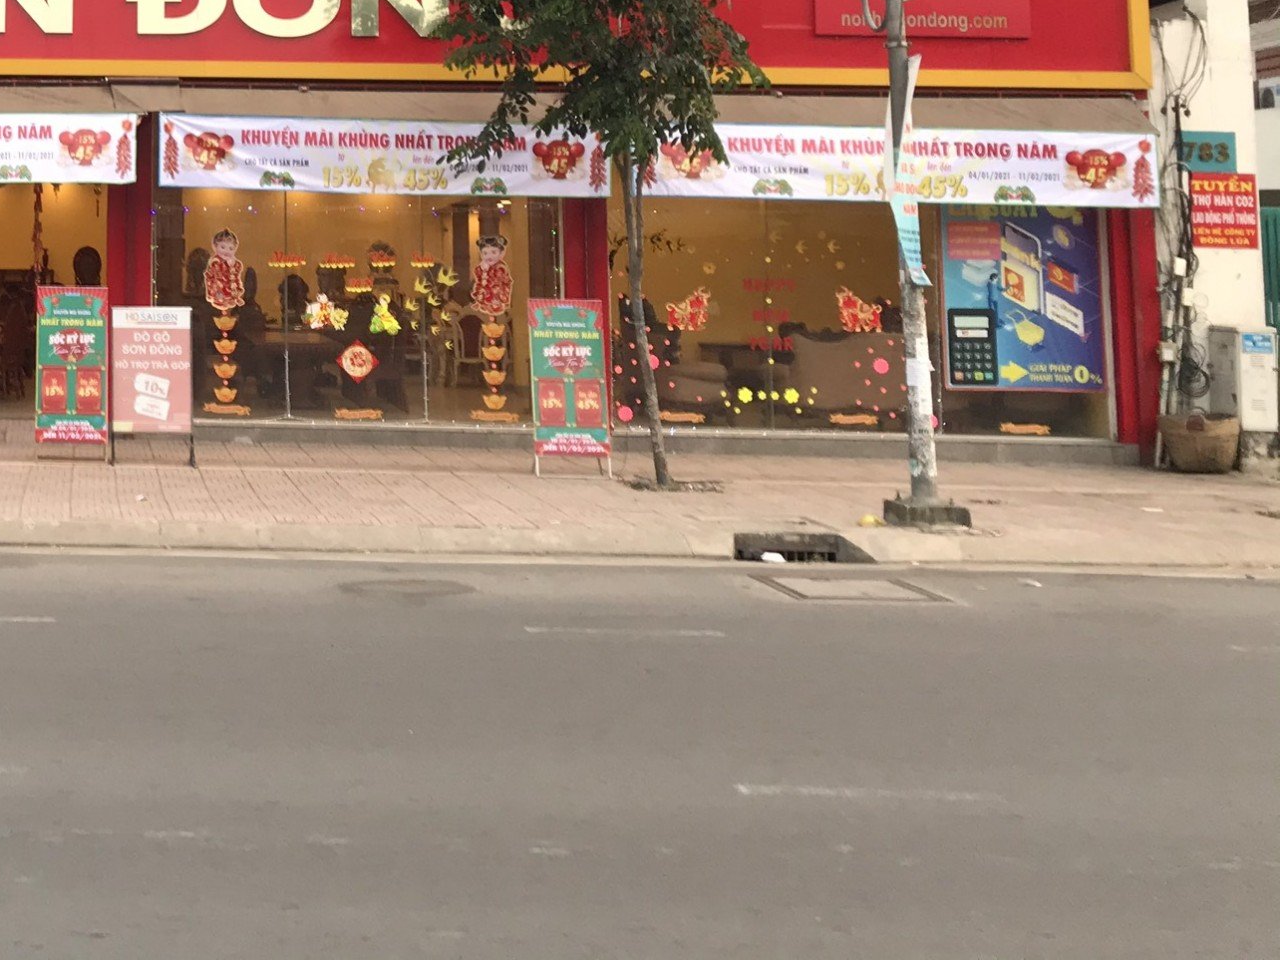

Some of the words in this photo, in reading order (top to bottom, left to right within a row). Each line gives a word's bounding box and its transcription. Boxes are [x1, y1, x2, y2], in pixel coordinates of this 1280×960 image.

[841, 11, 1008, 32] noihondong.com
[438, 133, 484, 152] TRON
[1183, 142, 1230, 163] 783
[322, 166, 361, 188] 15%
[403, 168, 448, 190] 45%
[824, 171, 870, 196] 15%
[918, 173, 968, 199] 45%
[1191, 175, 1253, 192] TUYỂN
[1192, 194, 1212, 208] THỢ
[1213, 193, 1234, 207] HÀN
[1235, 195, 1254, 207] CO2
